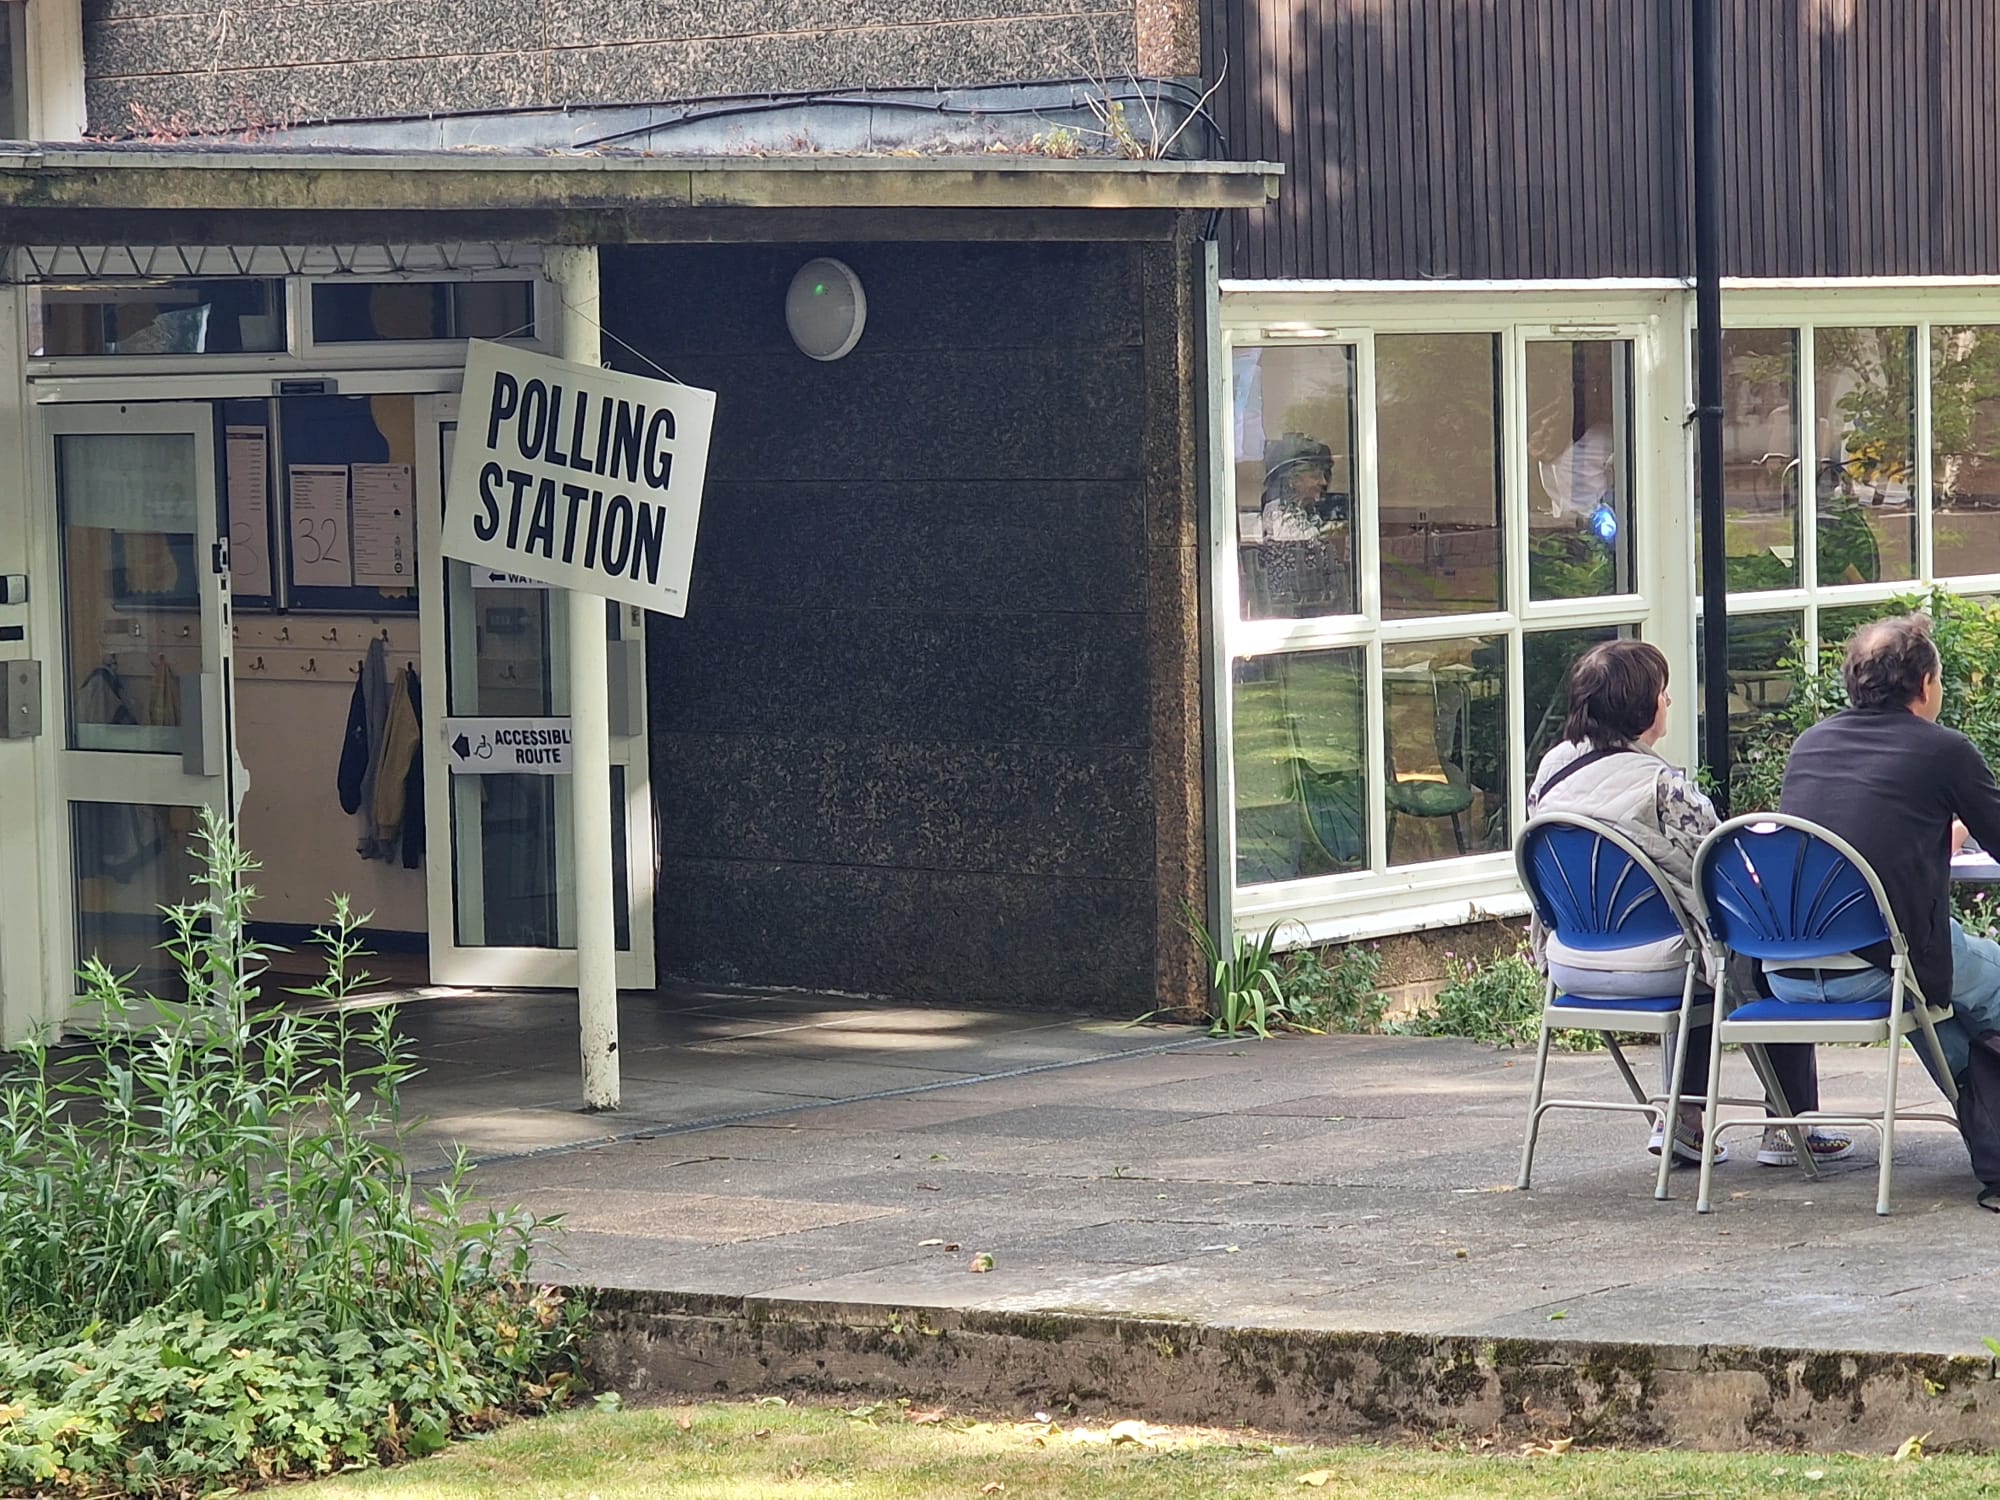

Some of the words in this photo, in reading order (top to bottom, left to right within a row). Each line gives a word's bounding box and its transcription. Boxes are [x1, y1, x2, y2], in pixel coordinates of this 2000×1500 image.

[487, 371, 676, 490] POLLING
[299, 518, 342, 564] 32
[473, 461, 667, 585] STATION
[494, 728, 571, 746] ACCESSIBL
[515, 747, 562, 765] ROUTE
